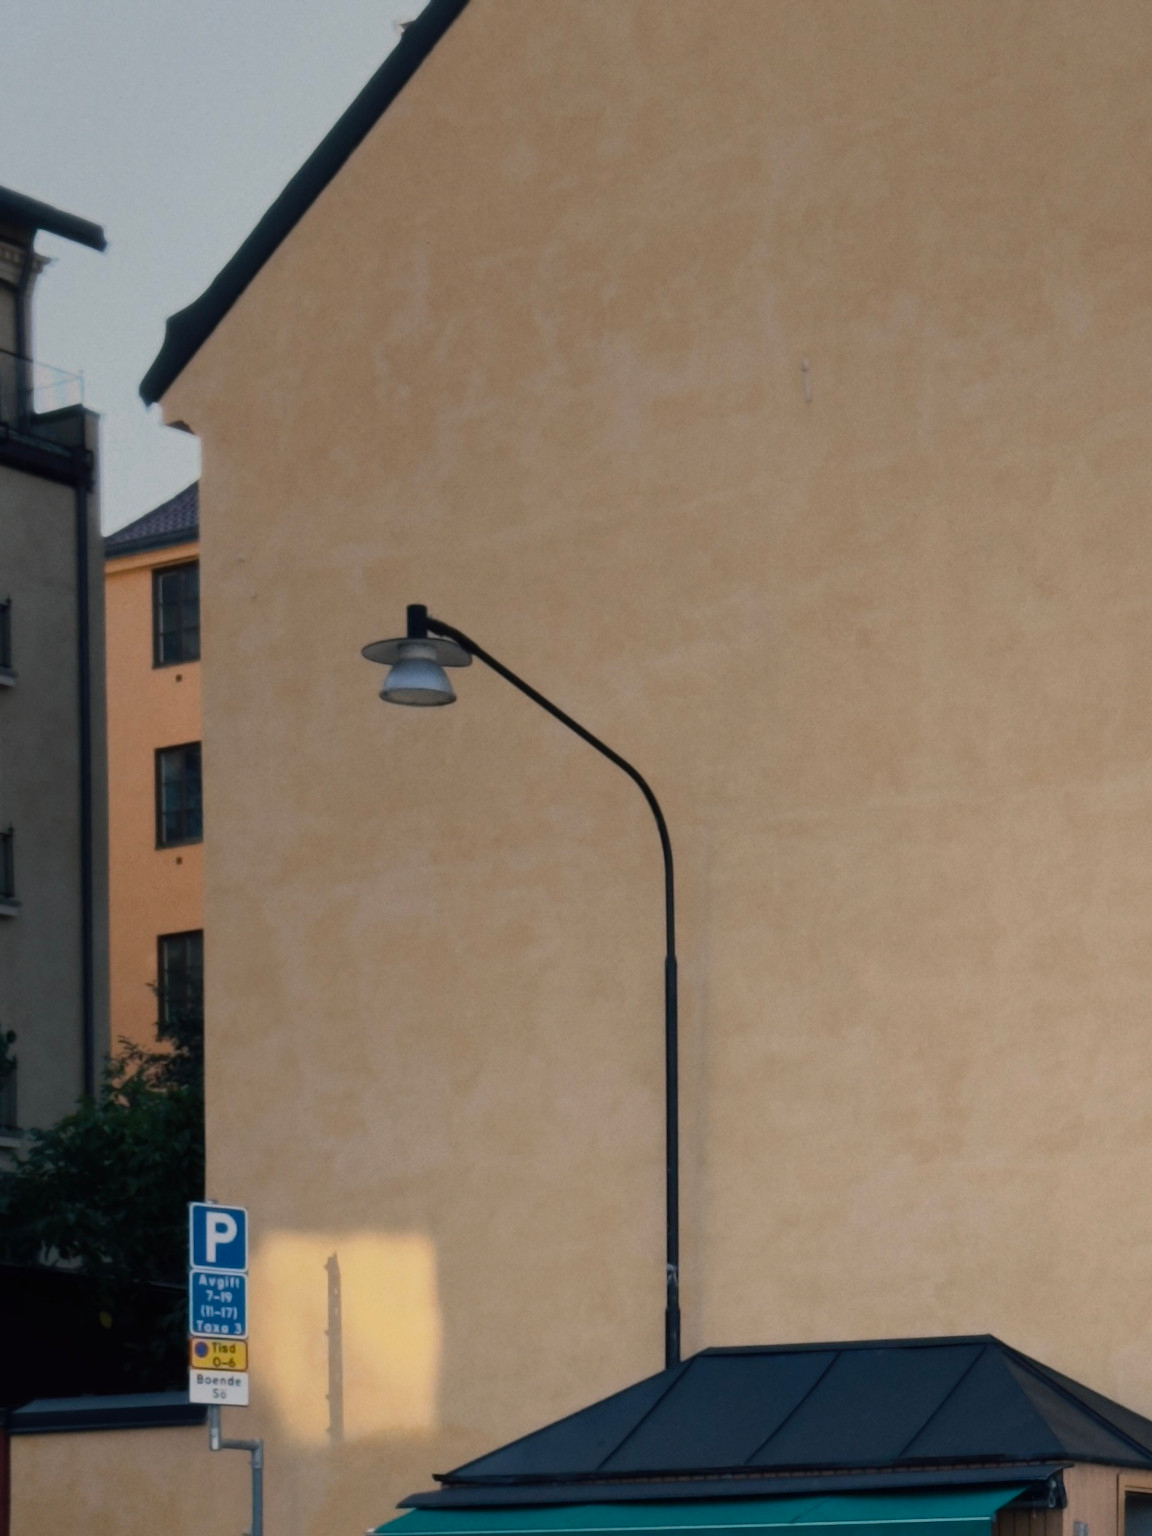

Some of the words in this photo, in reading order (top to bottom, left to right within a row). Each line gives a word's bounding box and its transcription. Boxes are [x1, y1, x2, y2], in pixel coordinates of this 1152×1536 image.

[206, 1211, 238, 1263] P
[198, 1274, 240, 1290] Avgift
[206, 1290, 233, 1303] 7-19
[200, 1304, 238, 1320] (11-17)
[196, 1320, 229, 1334] Taxa
[234, 1322, 243, 1335] 3
[211, 1342, 236, 1354] Tisd
[196, 1374, 242, 1387] Boende
